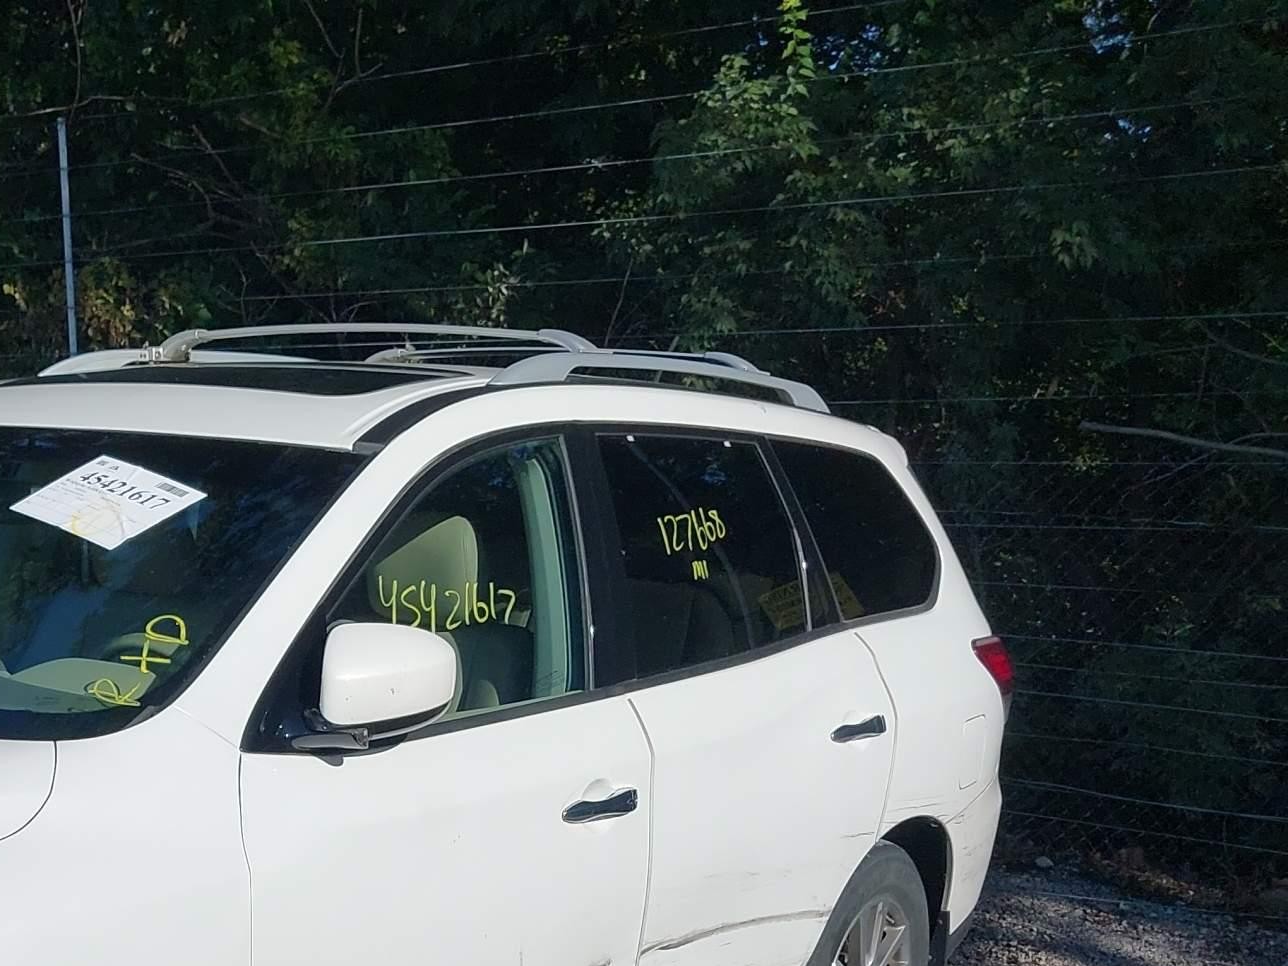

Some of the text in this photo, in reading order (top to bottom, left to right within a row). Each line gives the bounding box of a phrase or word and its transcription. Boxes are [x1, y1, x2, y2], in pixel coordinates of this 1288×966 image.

[79, 471, 171, 510] 45421617
[656, 506, 726, 556] 127668
[378, 575, 516, 634] 45421617
